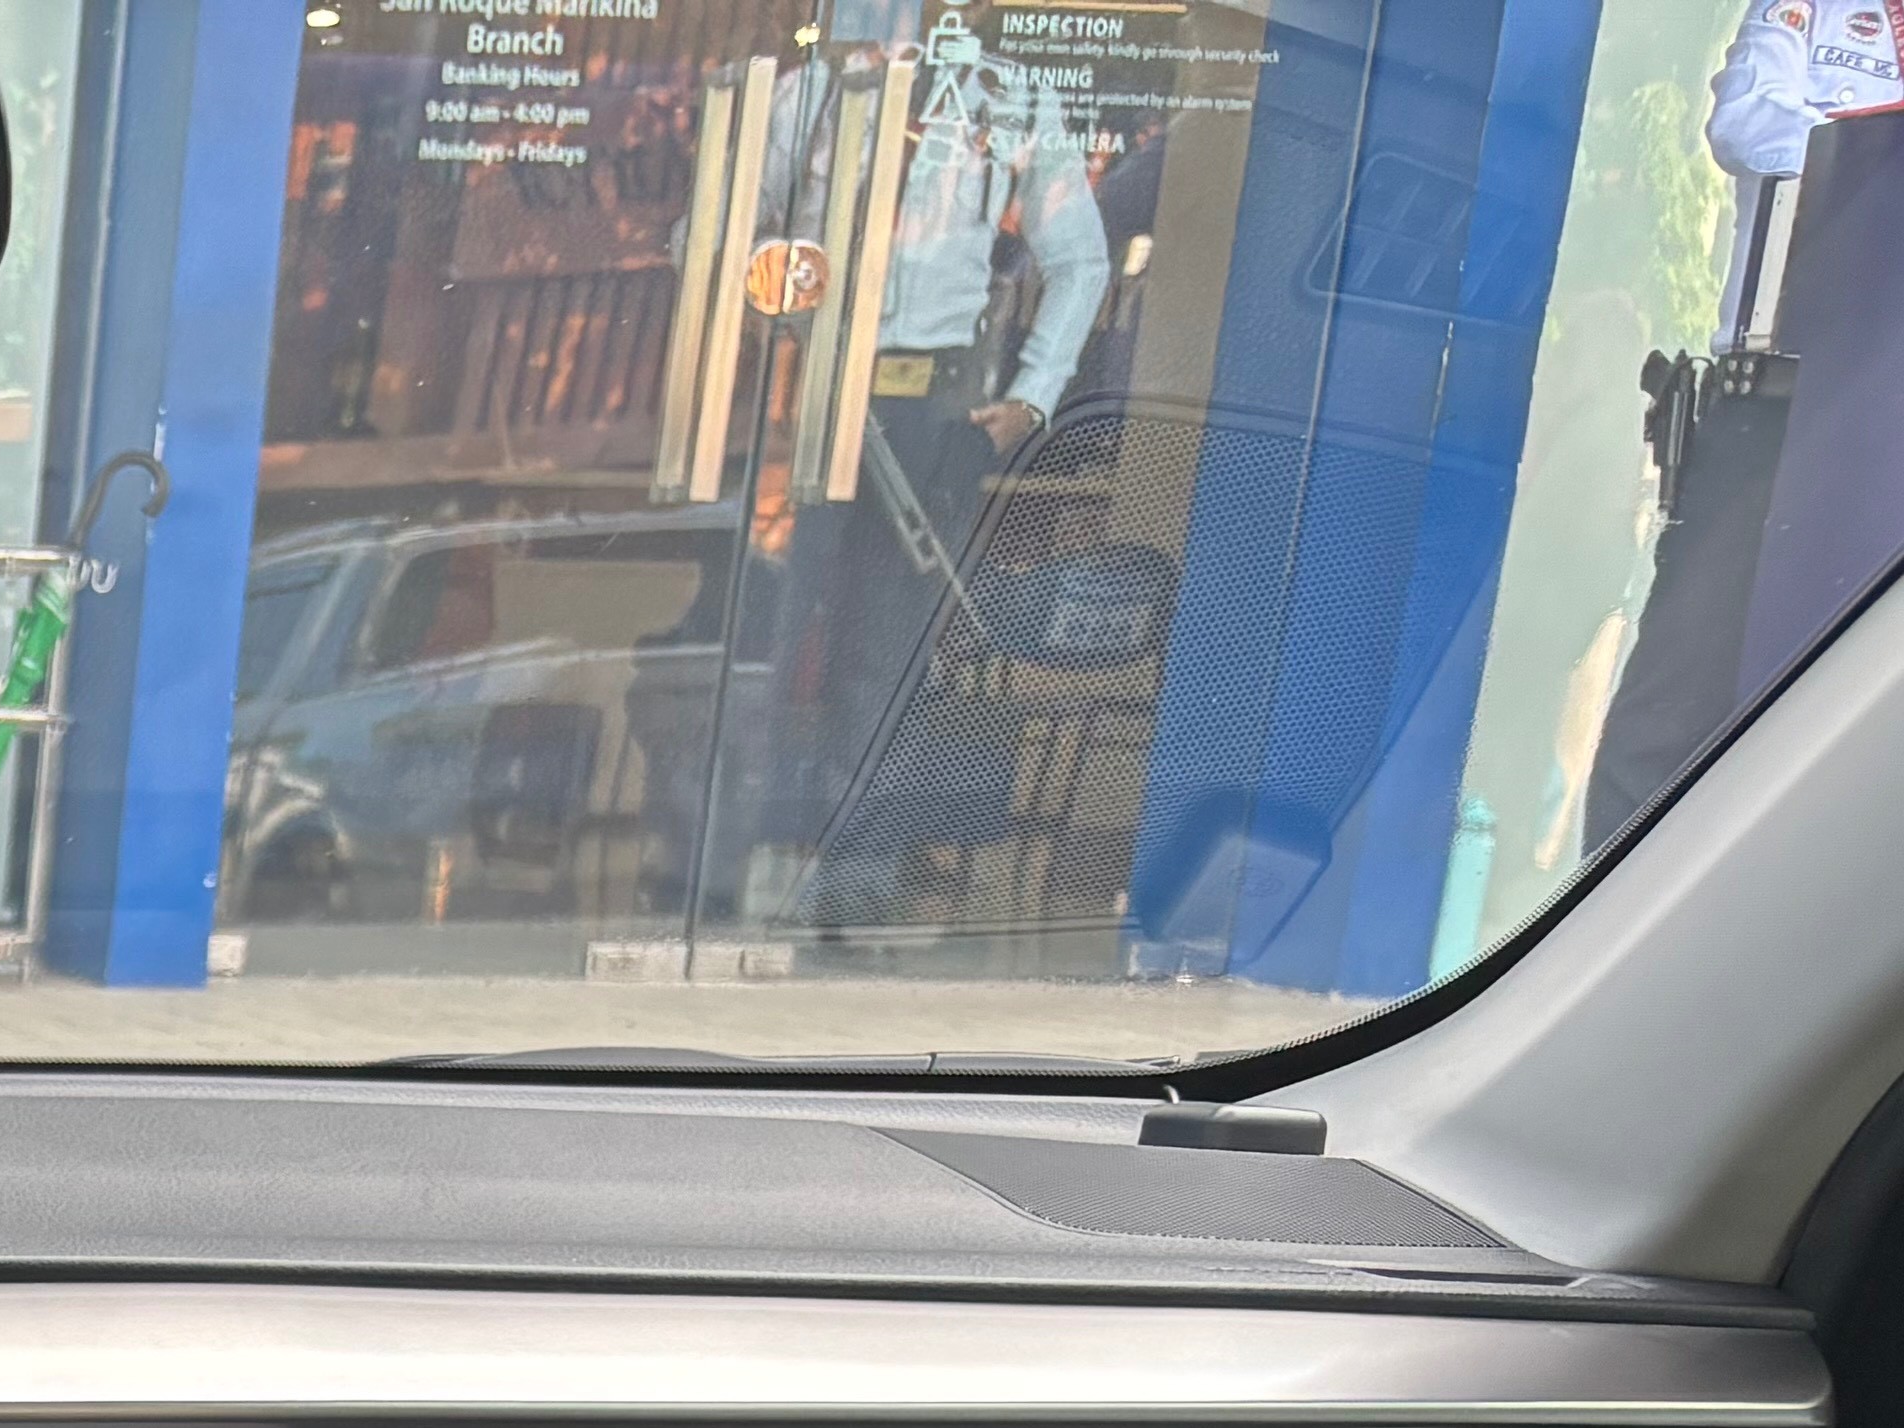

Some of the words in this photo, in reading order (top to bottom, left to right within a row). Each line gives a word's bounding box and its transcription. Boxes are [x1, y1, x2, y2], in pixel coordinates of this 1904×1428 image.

[466, 22, 564, 55] Branch
[1002, 13, 1124, 39] INSPECTION
[1248, 48, 1280, 64] check
[442, 60, 521, 91] Banking
[524, 64, 581, 88] Hours
[425, 100, 468, 123] 9:00
[469, 104, 500, 123] am
[556, 106, 590, 129] pm
